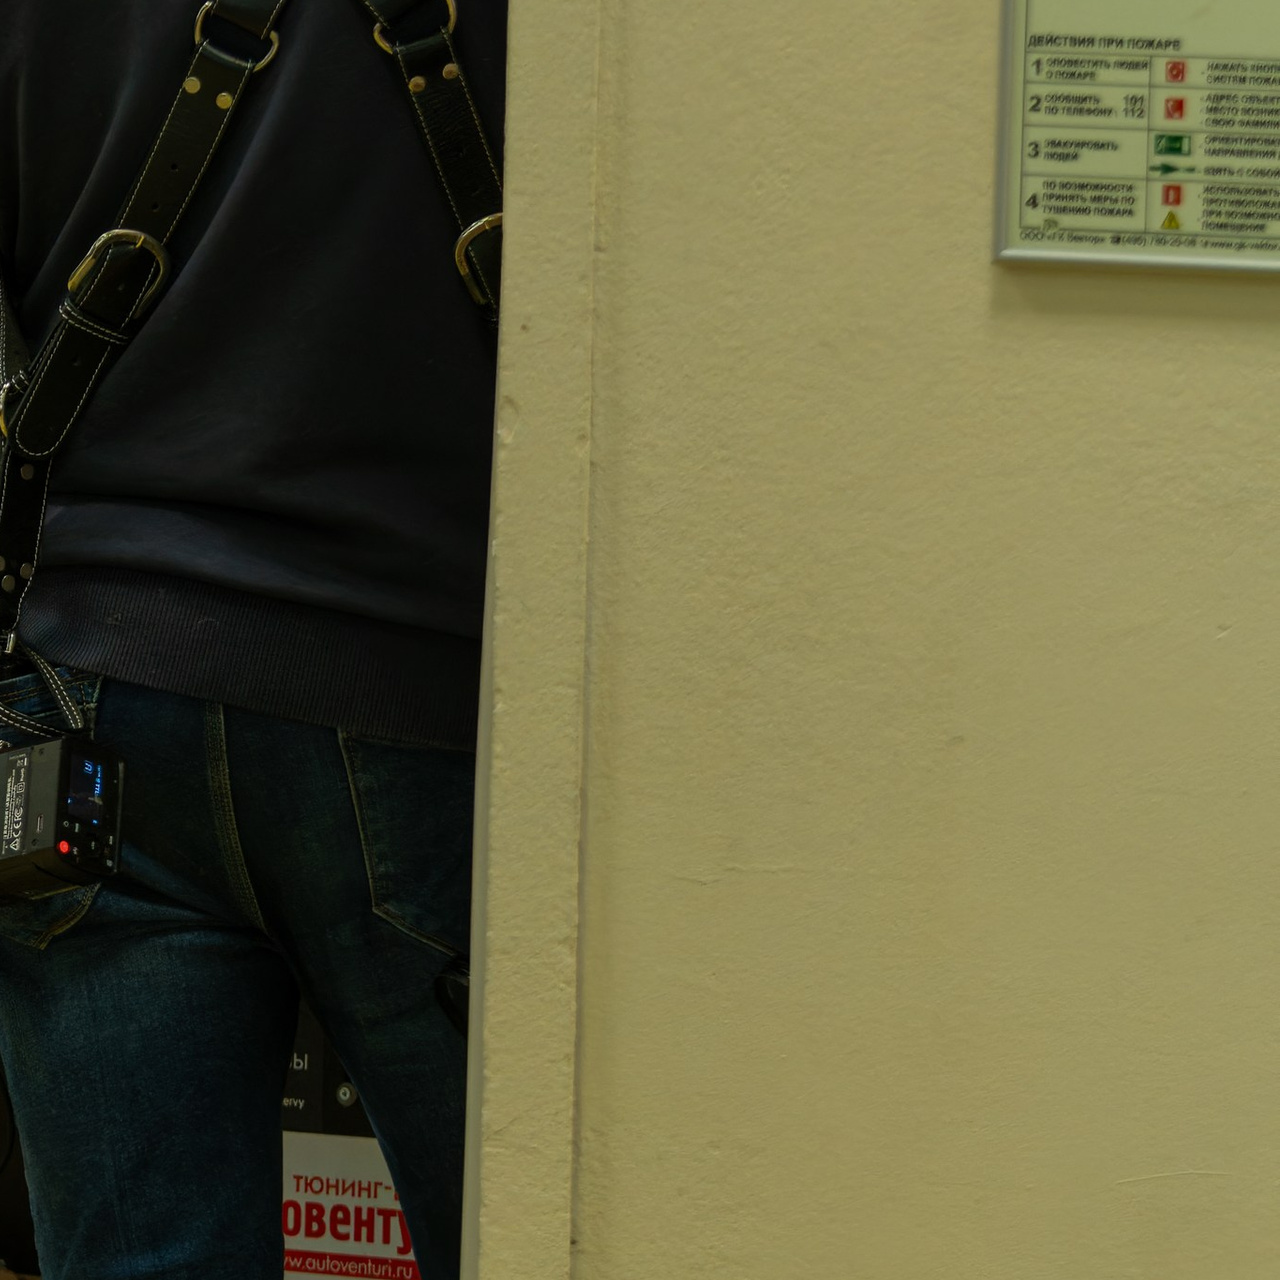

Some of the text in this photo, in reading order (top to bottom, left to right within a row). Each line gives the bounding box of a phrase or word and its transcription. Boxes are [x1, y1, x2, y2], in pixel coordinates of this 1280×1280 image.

[1028, 34, 1181, 51] ДЕЙСТВИЯ ПРИ ПОЖАРЕ
[1029, 94, 1042, 113] 2
[1027, 141, 1039, 158] 3
[1025, 193, 1039, 209] 4
